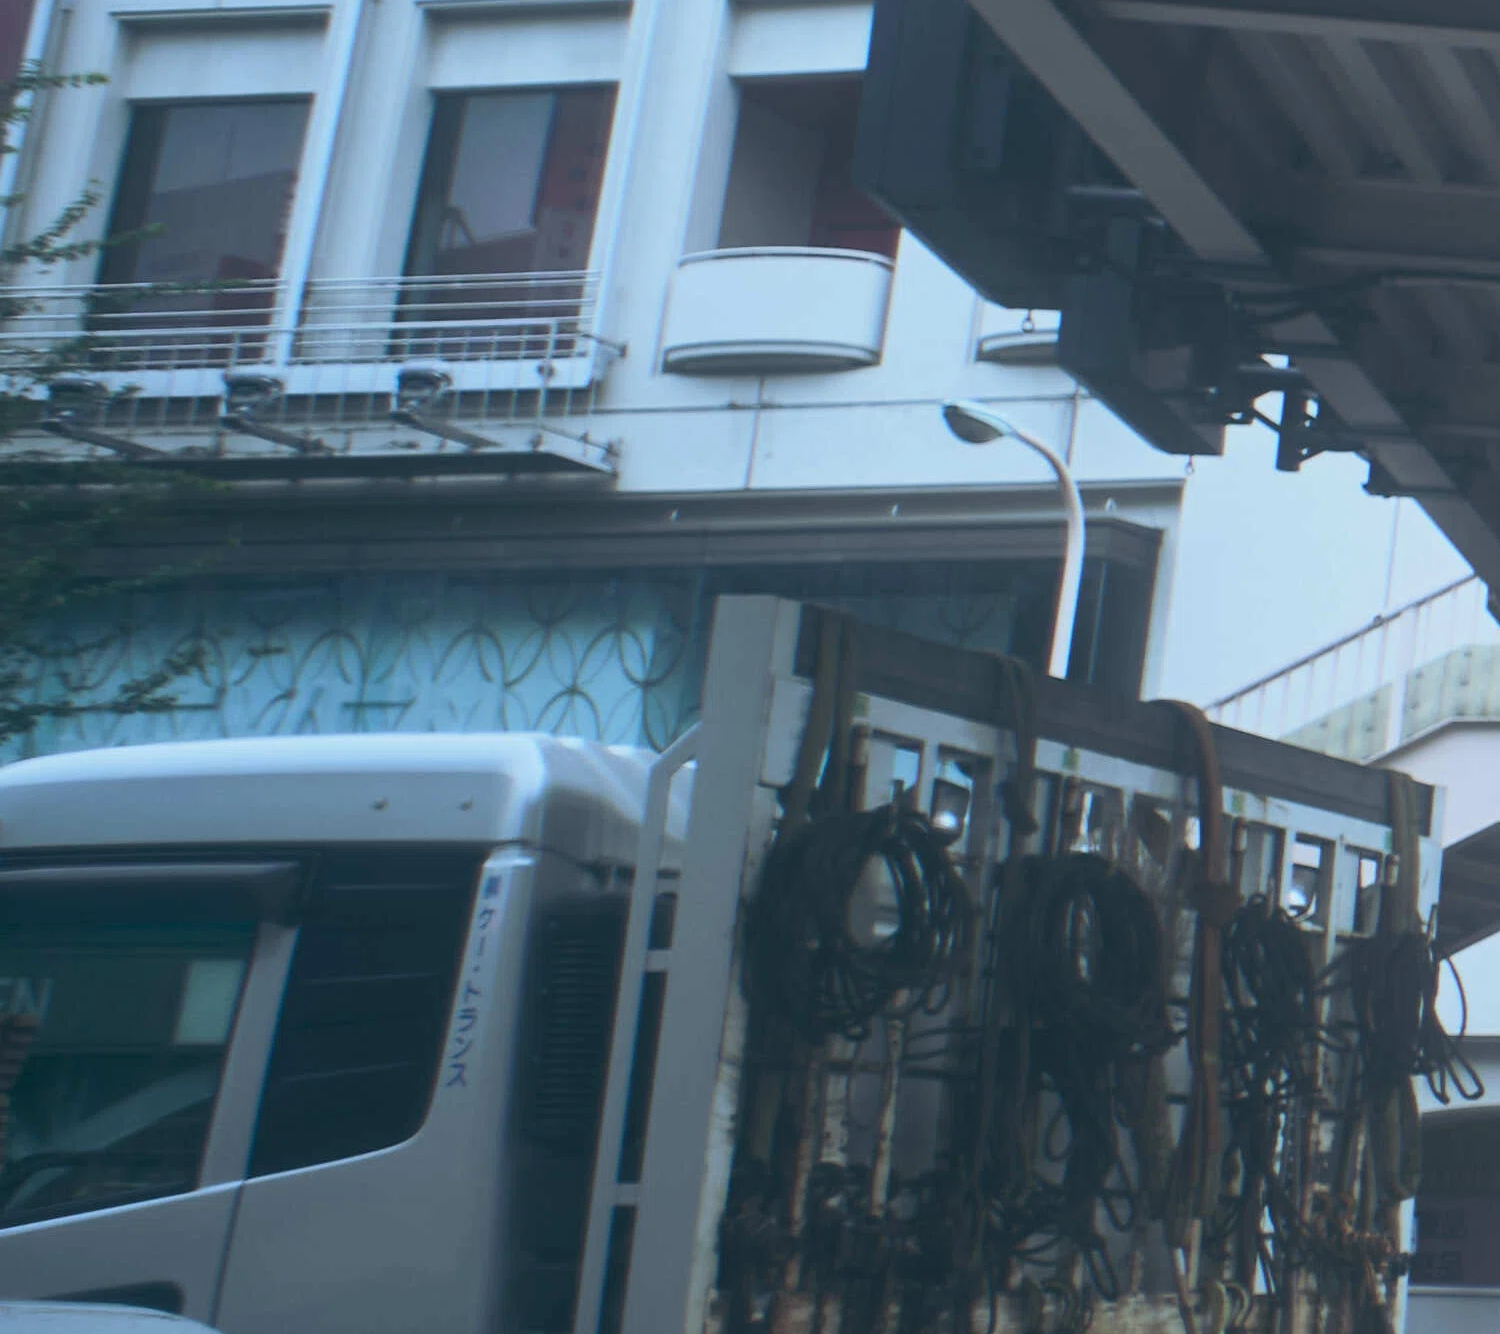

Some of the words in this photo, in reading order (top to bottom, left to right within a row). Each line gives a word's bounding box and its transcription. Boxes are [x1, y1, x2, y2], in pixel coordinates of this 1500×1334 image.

[446, 875, 501, 1088] ケー・トランス
